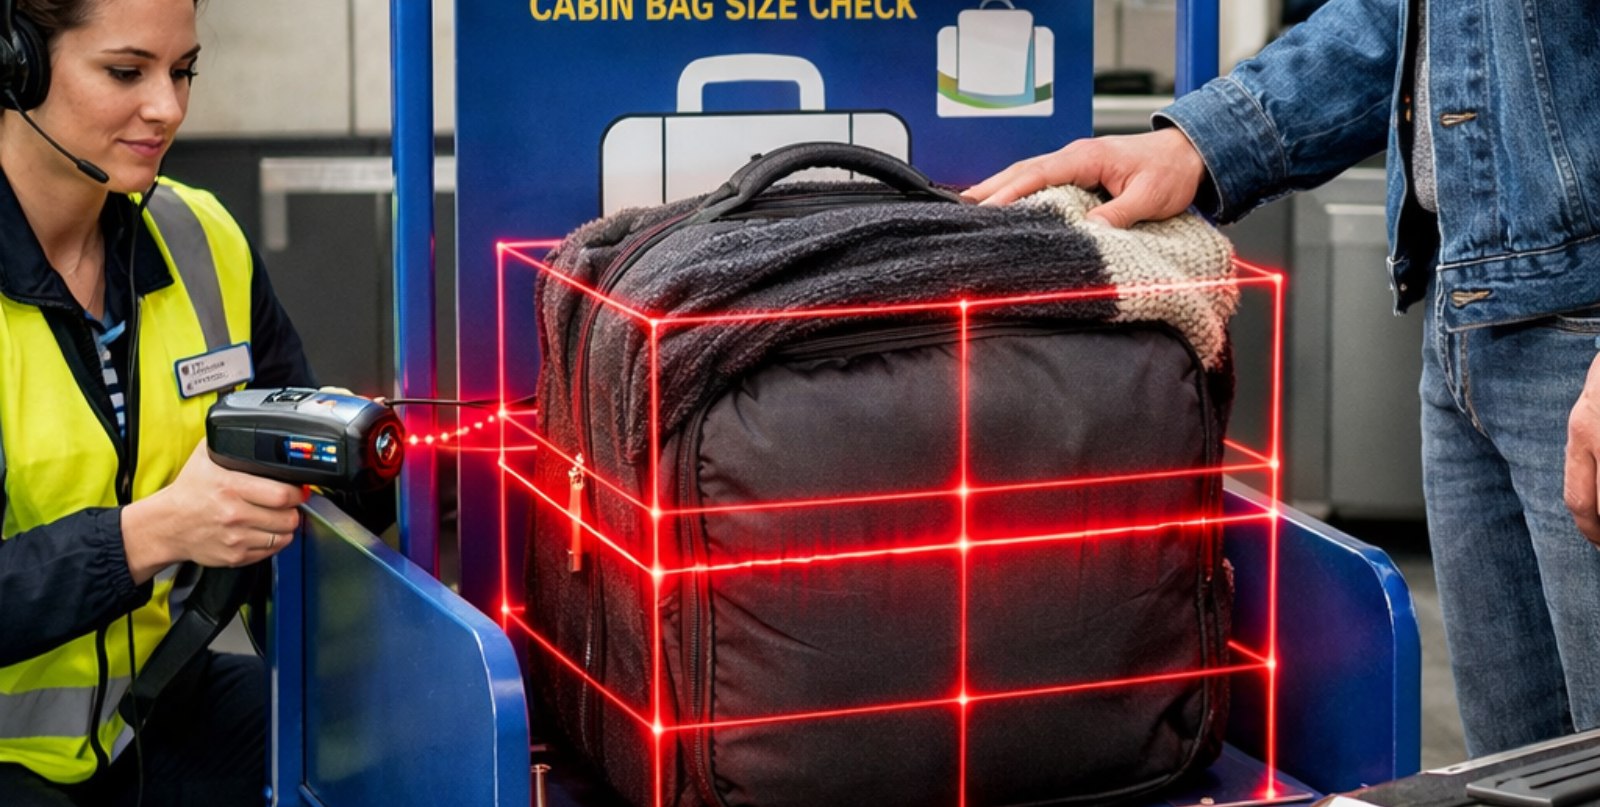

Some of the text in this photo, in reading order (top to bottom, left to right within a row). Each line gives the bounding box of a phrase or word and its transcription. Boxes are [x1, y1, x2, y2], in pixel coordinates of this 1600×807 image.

[529, 0, 917, 21] CABIN BAG SIZE CHECK
